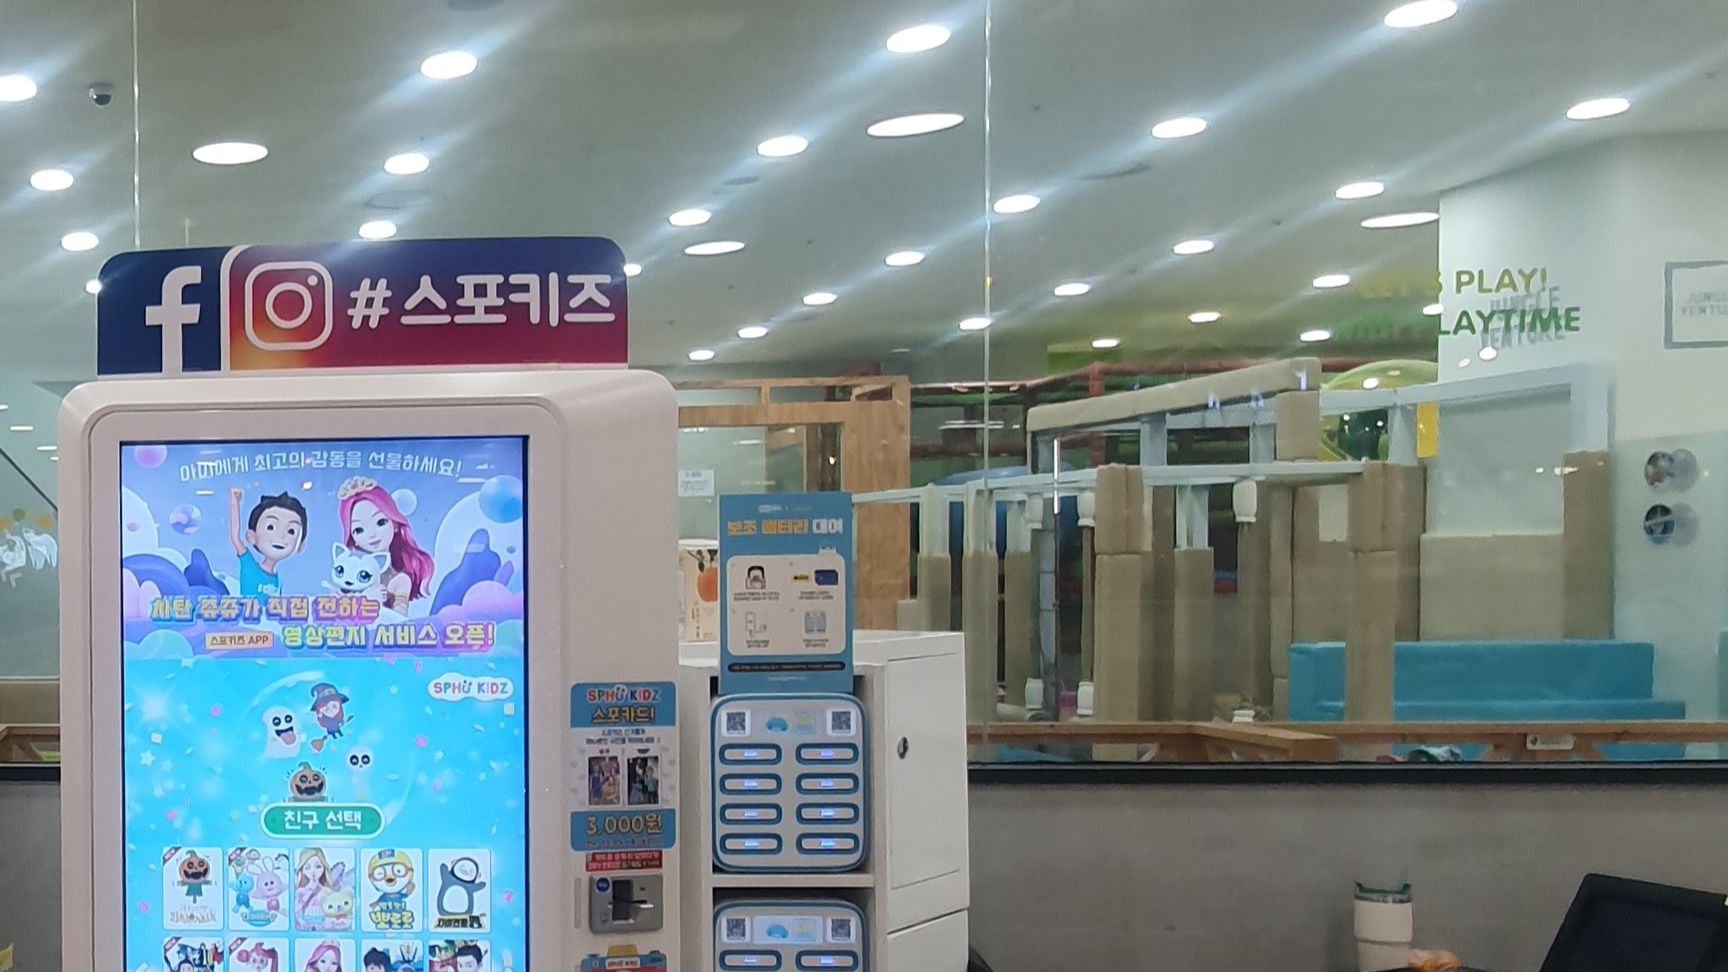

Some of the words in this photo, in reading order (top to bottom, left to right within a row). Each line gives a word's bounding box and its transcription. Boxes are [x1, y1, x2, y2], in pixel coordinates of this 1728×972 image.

[1455, 267, 1547, 295] PLAY!
[347, 271, 616, 329] #스포키즈
[1437, 306, 1581, 336] LAYTIME
[254, 452, 306, 471] 최고의
[311, 450, 362, 469] 감동을
[368, 451, 463, 478] 선물하세요!
[267, 596, 310, 620] 직접
[315, 596, 380, 620] 전하는
[248, 634, 269, 645] APP
[282, 624, 366, 648] 영상편지
[374, 623, 438, 647] 서비스
[444, 623, 495, 648] 오픈!
[477, 682, 509, 694] KIDZ
[629, 688, 661, 702] KIDZ
[283, 810, 320, 831] 친구
[325, 810, 362, 831] 선택
